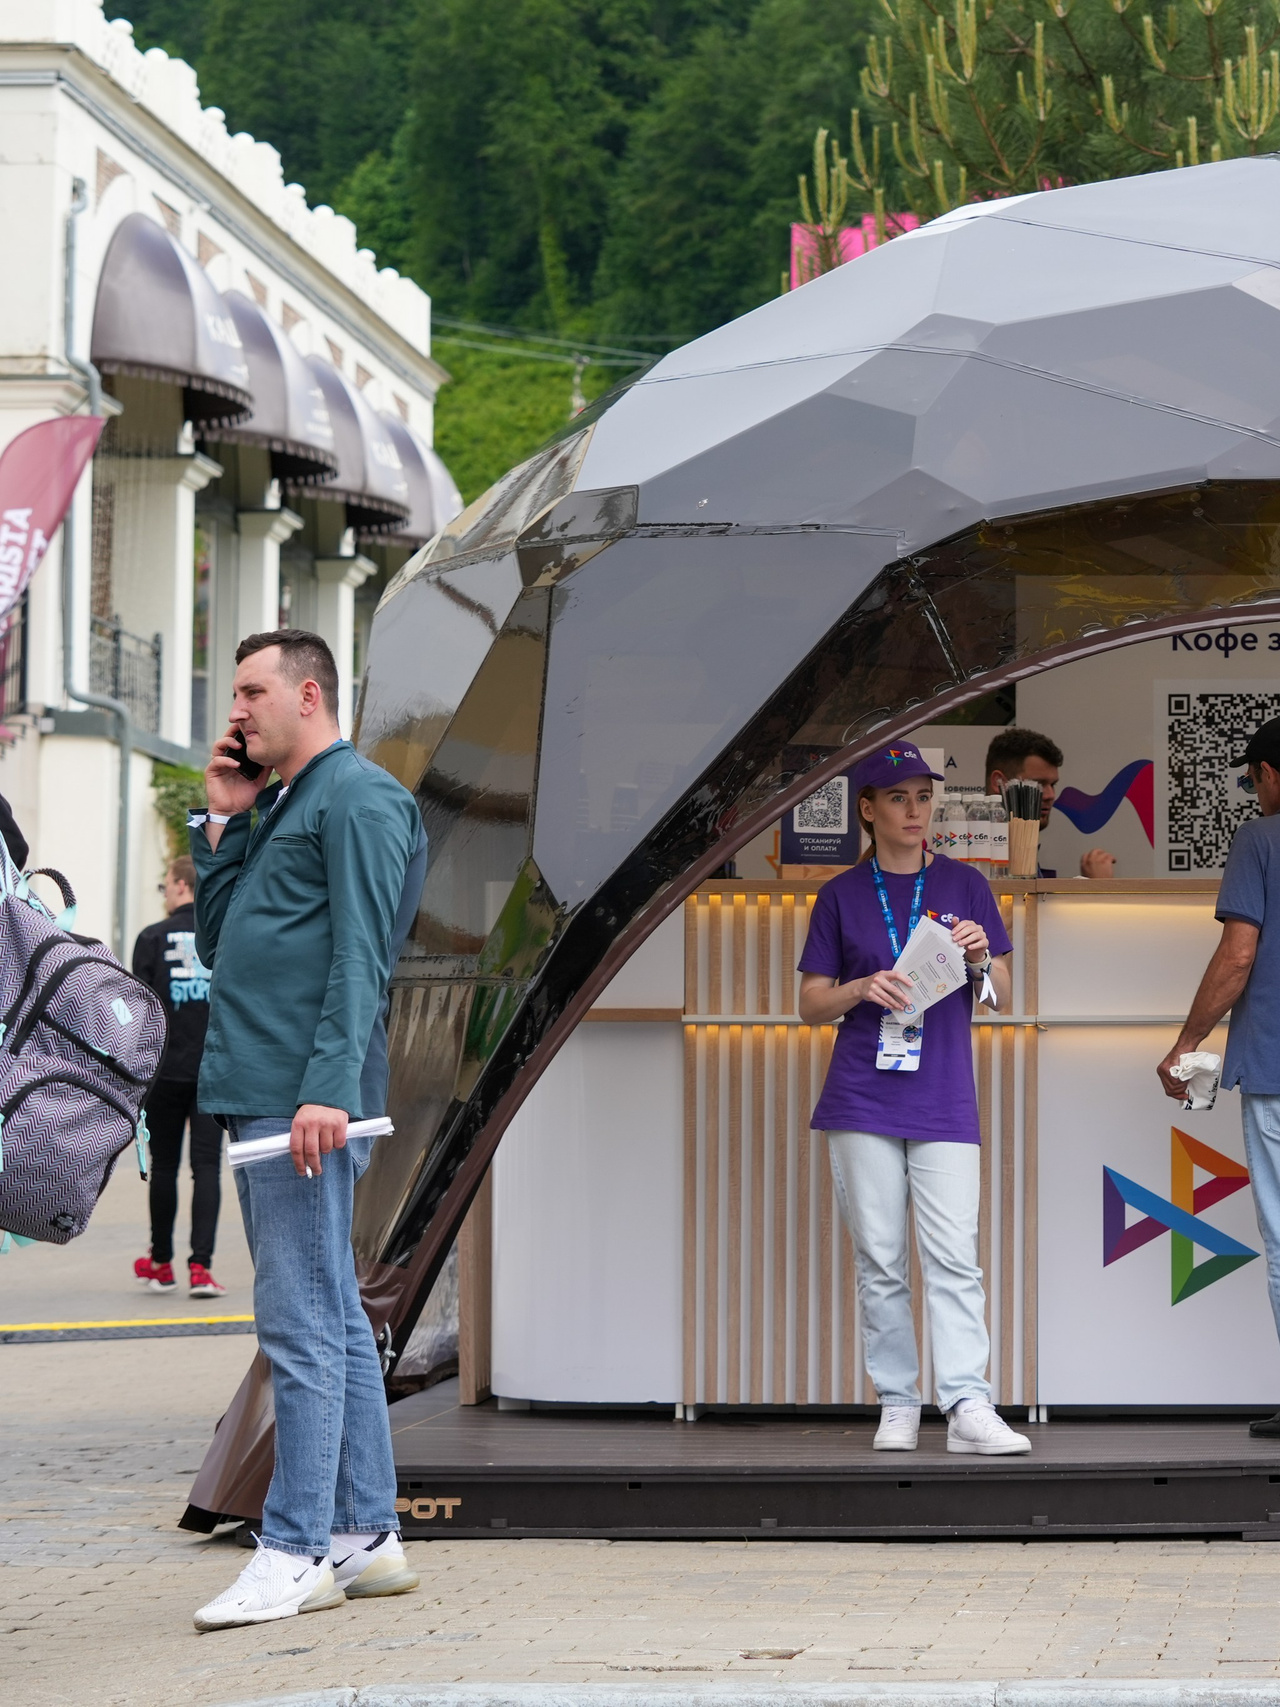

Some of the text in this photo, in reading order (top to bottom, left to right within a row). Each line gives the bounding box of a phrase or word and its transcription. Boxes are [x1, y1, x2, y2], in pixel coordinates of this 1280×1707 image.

[1172, 626, 1258, 658] Кофе
[800, 837, 841, 845] ОТСКАНИРУЙ
[974, 833, 988, 841] сбп
